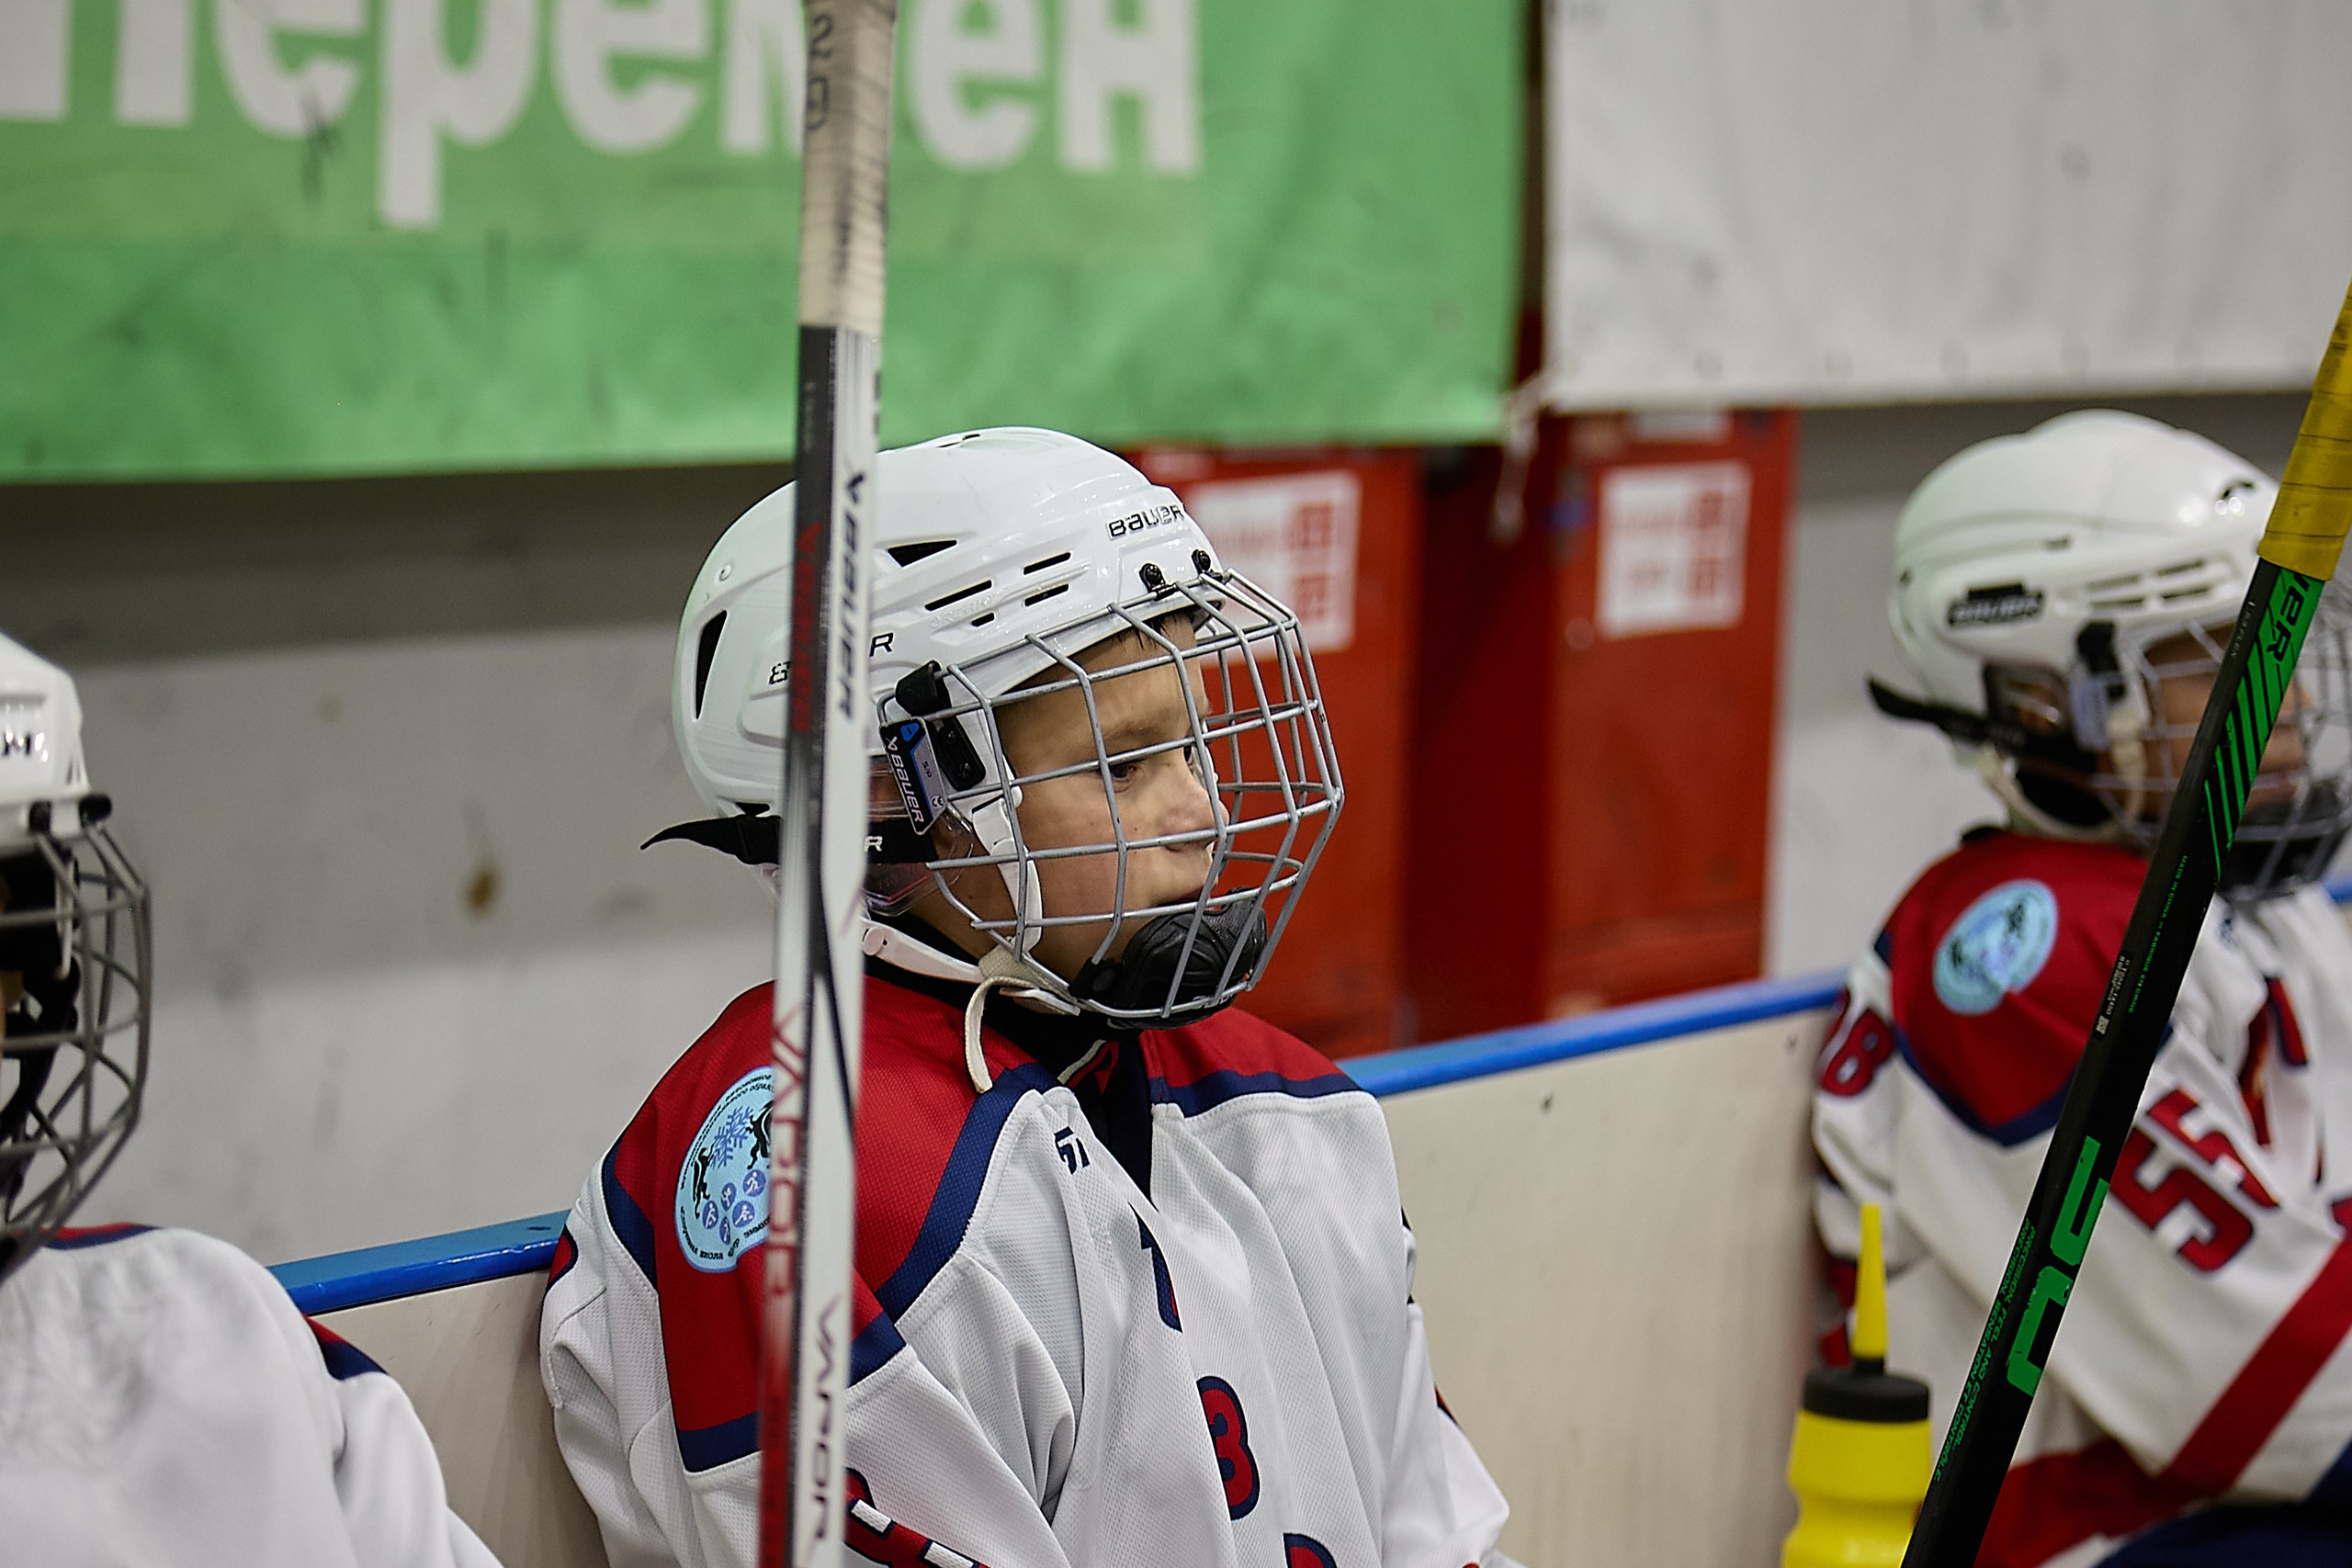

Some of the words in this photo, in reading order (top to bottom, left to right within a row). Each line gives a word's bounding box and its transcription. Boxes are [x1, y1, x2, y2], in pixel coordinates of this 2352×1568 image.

[1108, 504, 1185, 539] BAUER
[838, 512, 860, 720] BAUER
[922, 761, 933, 778] S/P
[889, 753, 924, 823] BAUER
[2176, 855, 2187, 879] MADE
[2171, 882, 2177, 890] IN
[2161, 893, 2175, 918] CHINA
[2137, 975, 2145, 987] EN
[2129, 988, 2141, 1012] CHINE
[767, 1003, 804, 1298] VAPOR
[2005, 1226, 2035, 1303] PRECISION,
[1971, 1301, 2001, 1379] SENSATION
[1991, 1308, 2007, 1341] FEEL
[1978, 1347, 1991, 1380] AND
[1964, 1382, 1972, 1401] ET
[806, 1293, 842, 1560] VAPOR
